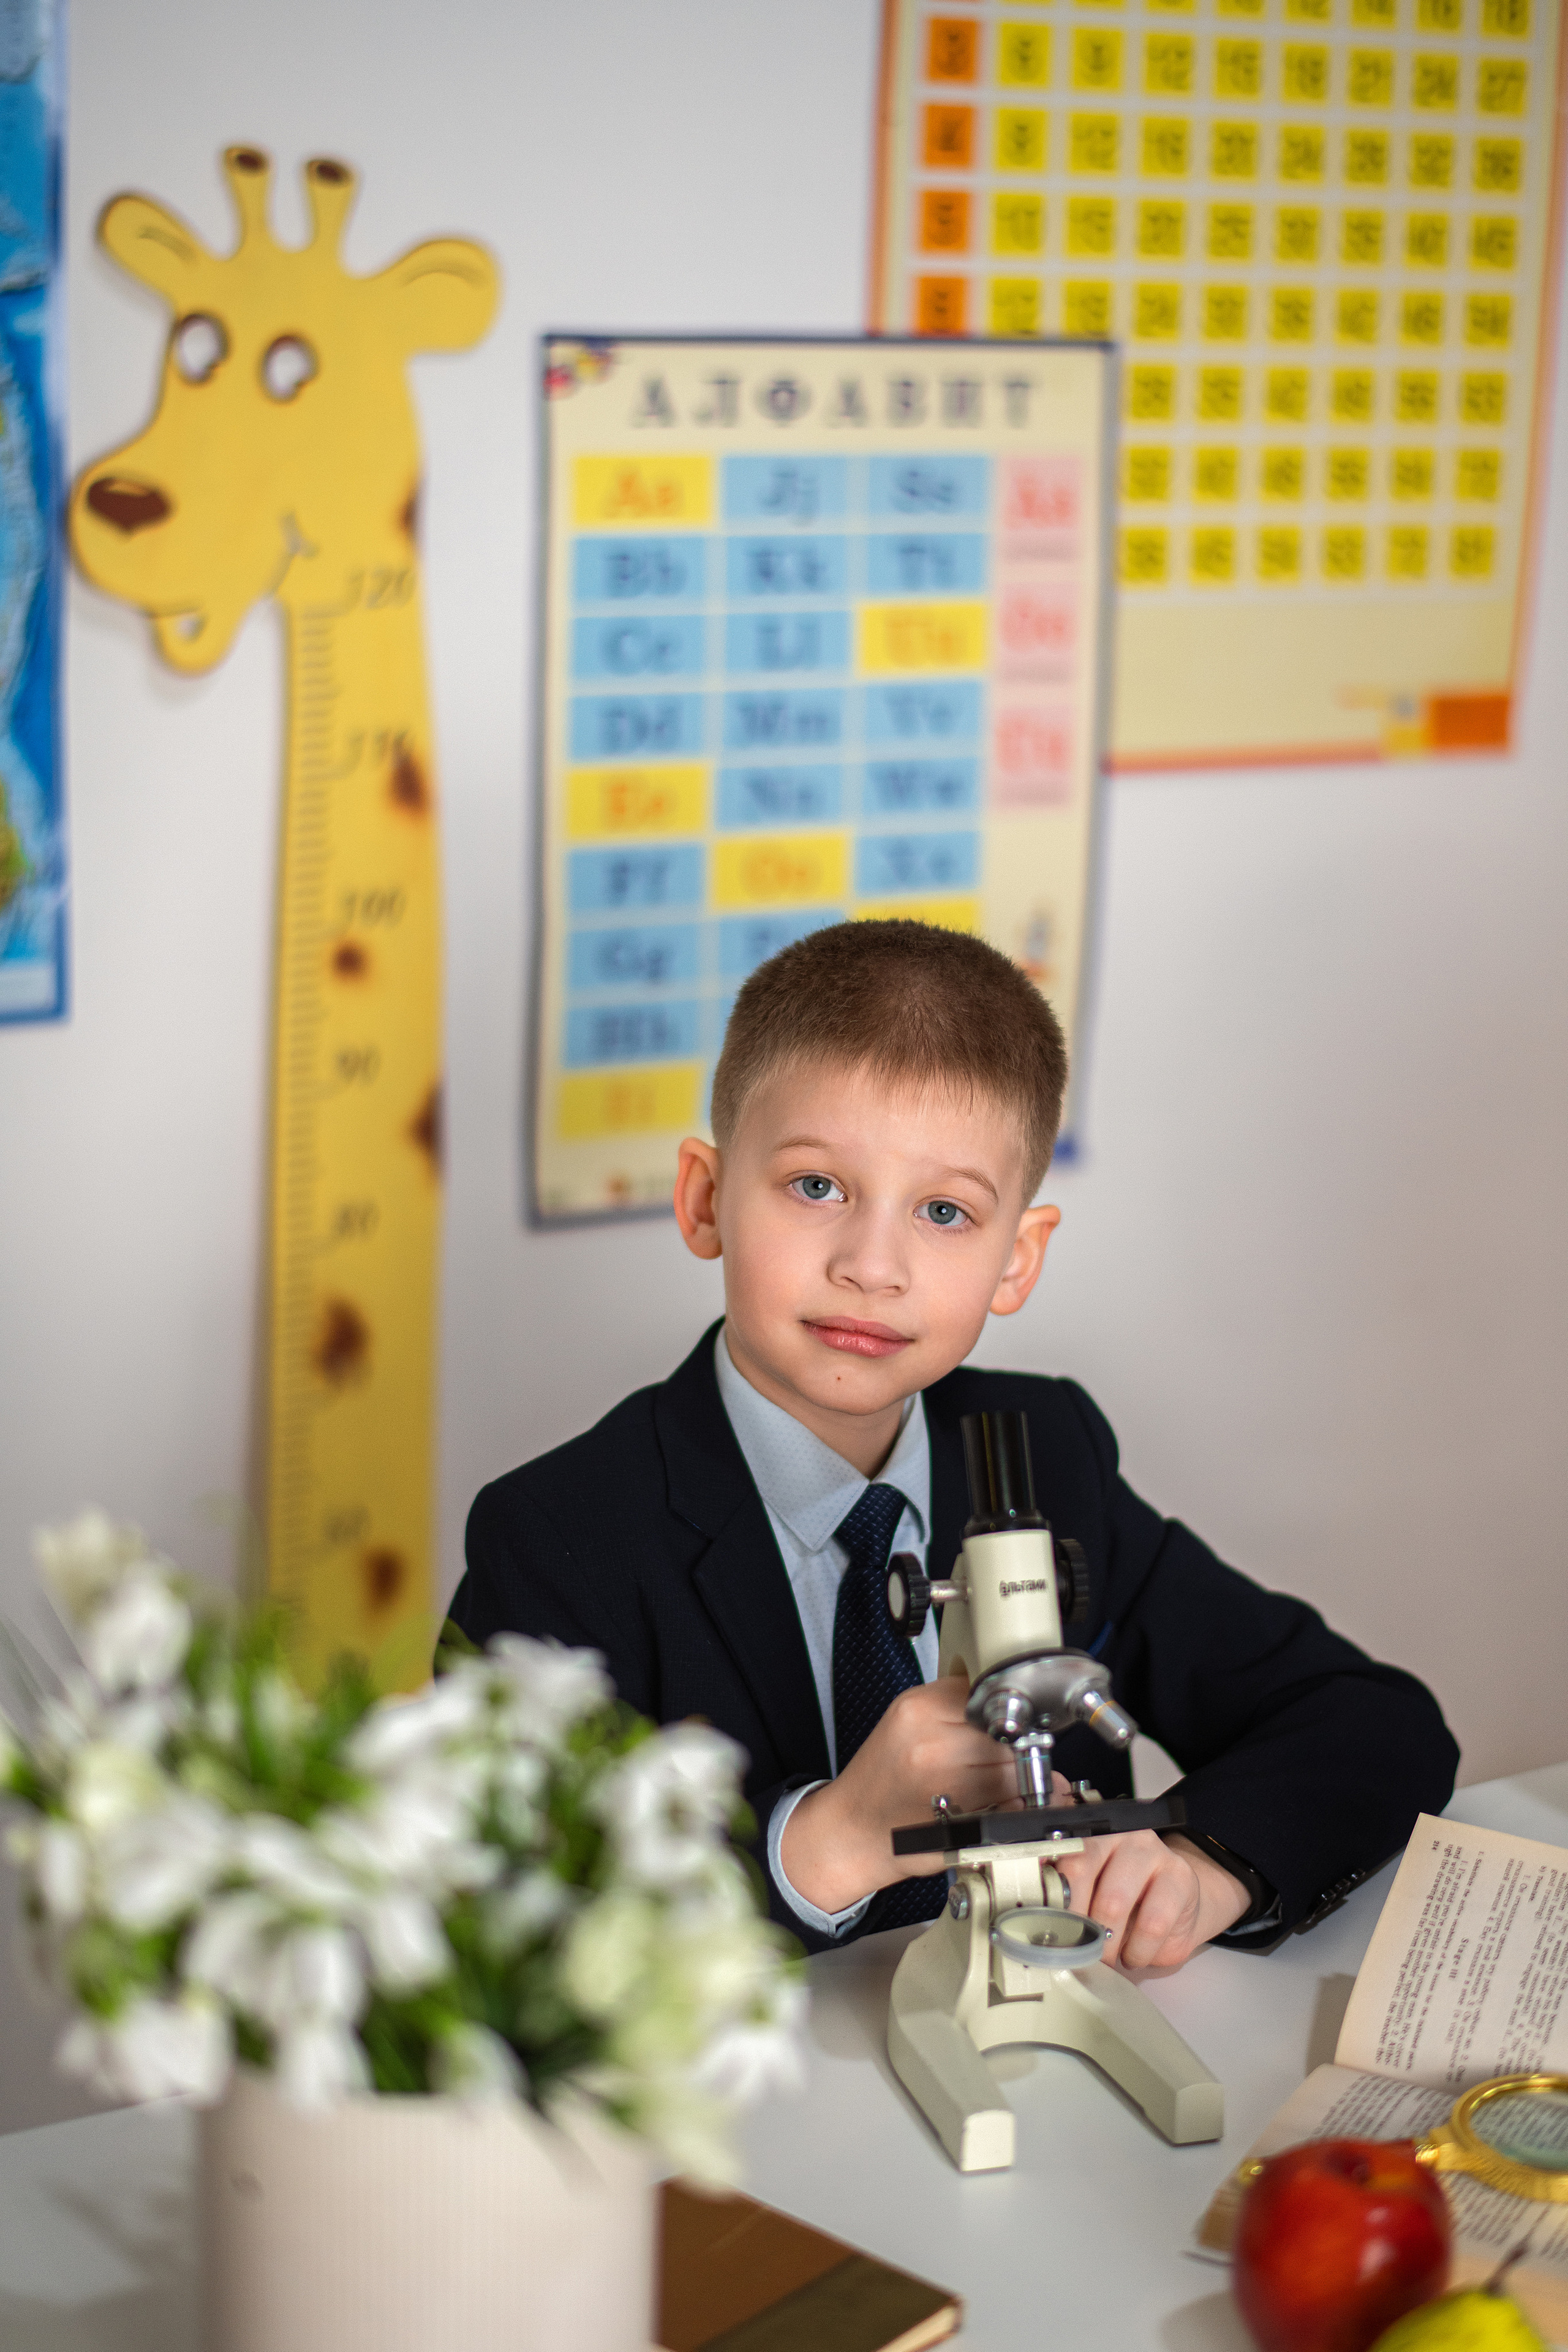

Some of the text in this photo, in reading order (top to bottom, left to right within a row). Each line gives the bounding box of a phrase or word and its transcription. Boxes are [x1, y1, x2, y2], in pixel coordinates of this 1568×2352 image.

[633, 372, 1039, 429] АЛФАВИТ
[347, 568, 417, 609] 120
[341, 886, 405, 927] 100
[1431, 1840, 1439, 1850] 214
[1442, 1842, 1455, 1858] ugh
[1453, 1845, 1464, 1860] and
[1439, 1858, 1449, 1870] the
[1447, 1861, 1458, 1875] will
[1466, 1858, 1482, 1887] Substitute
[1502, 1858, 1517, 1882] нашей
[1455, 1868, 1465, 1880] I'm
[1545, 1869, 1559, 1887] good
[1425, 1870, 1445, 1901] drawing
[1434, 1885, 1447, 1902] very
[1446, 1881, 1460, 1903] afraid
[1462, 1888, 1471, 1898] the
[1551, 1872, 1568, 1902] wouldn't
[1422, 1901, 1432, 1916] was
[1430, 1903, 1442, 1919] well
[1434, 1903, 1452, 1927] you're
[1455, 1899, 1467, 1917] active
[1544, 1904, 1556, 1922] have
[1417, 1917, 1427, 1928] far
[1410, 1929, 1423, 1948] from
[1417, 1927, 1433, 1948] given
[1428, 1928, 1442, 1950] unfair
[1400, 1947, 1416, 1969] being
[1451, 1937, 1469, 1967] Stage
[1409, 1950, 1425, 1978] another
[1420, 1961, 1431, 1973] the
[1409, 1973, 1425, 1999] young
[1387, 2000, 1398, 2014] the
[1379, 2015, 1393, 2045] teacher
